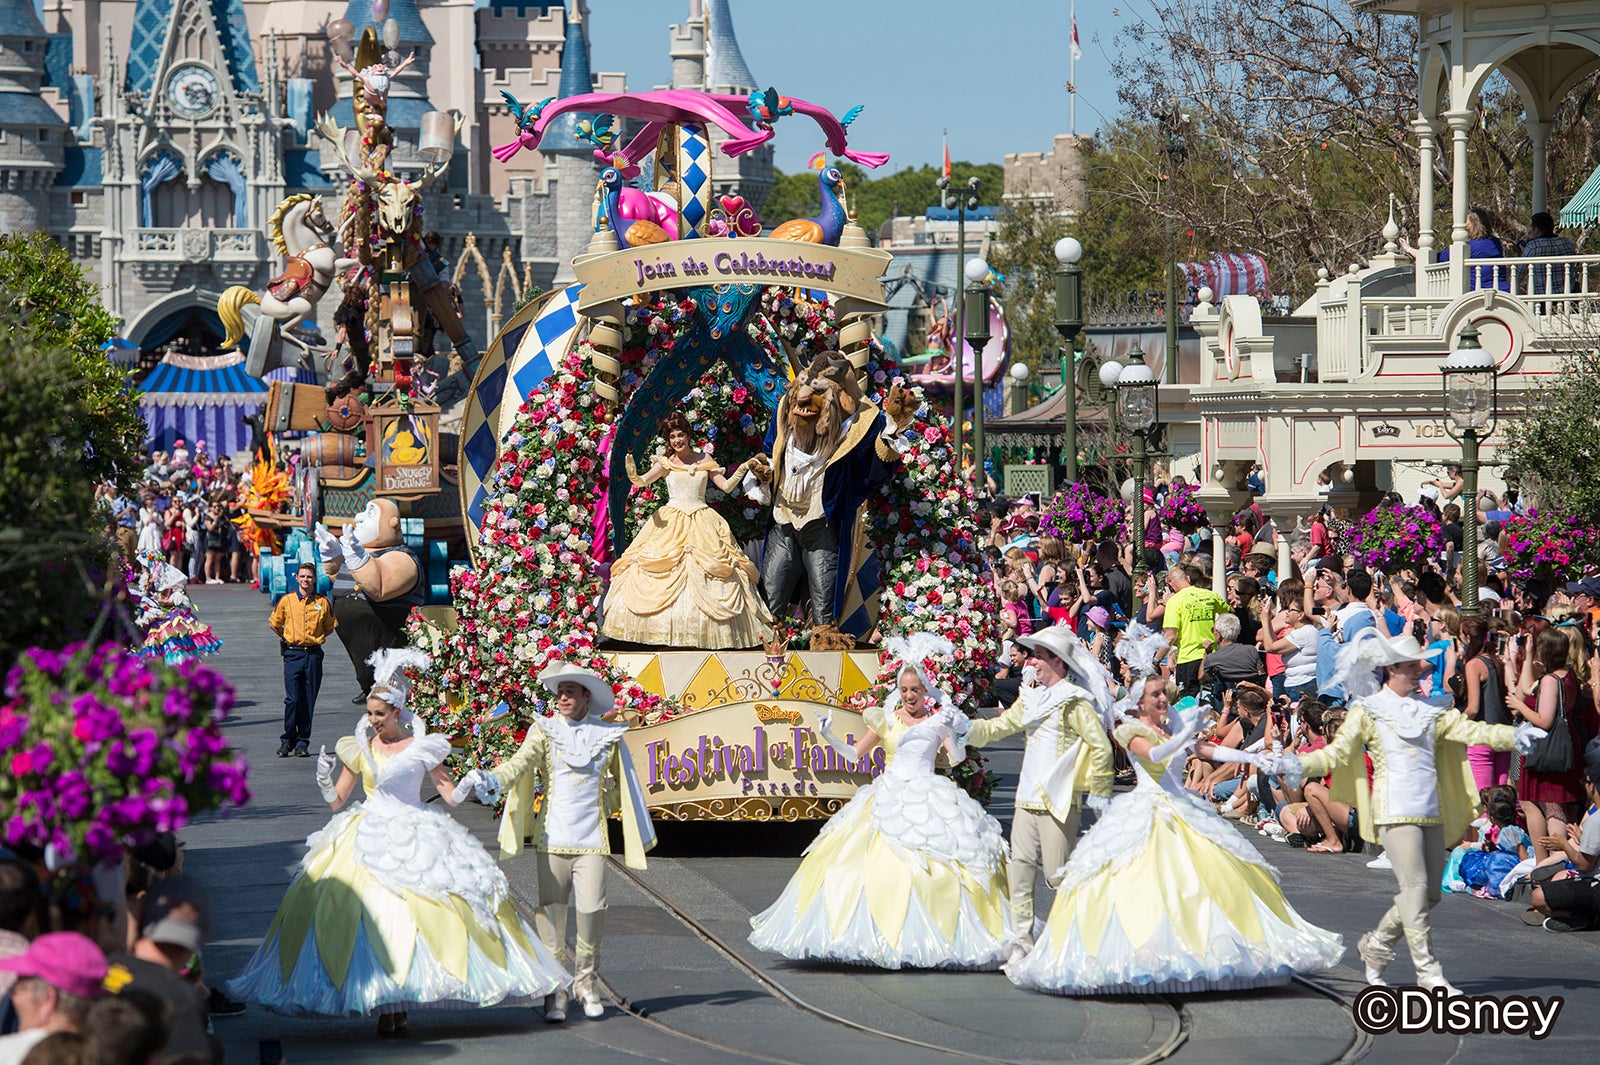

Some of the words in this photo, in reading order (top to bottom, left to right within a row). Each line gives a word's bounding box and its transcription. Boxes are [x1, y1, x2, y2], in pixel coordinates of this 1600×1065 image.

[634, 256, 674, 286] Join
[682, 256, 707, 272] the
[714, 252, 834, 277] Celebration!
[1415, 425, 1445, 438] ICE
[395, 466, 432, 480] SNUGGLY
[754, 704, 800, 725] Disney
[645, 726, 764, 788] Festival
[789, 726, 886, 779] Fantas
[741, 777, 816, 795] Parade
